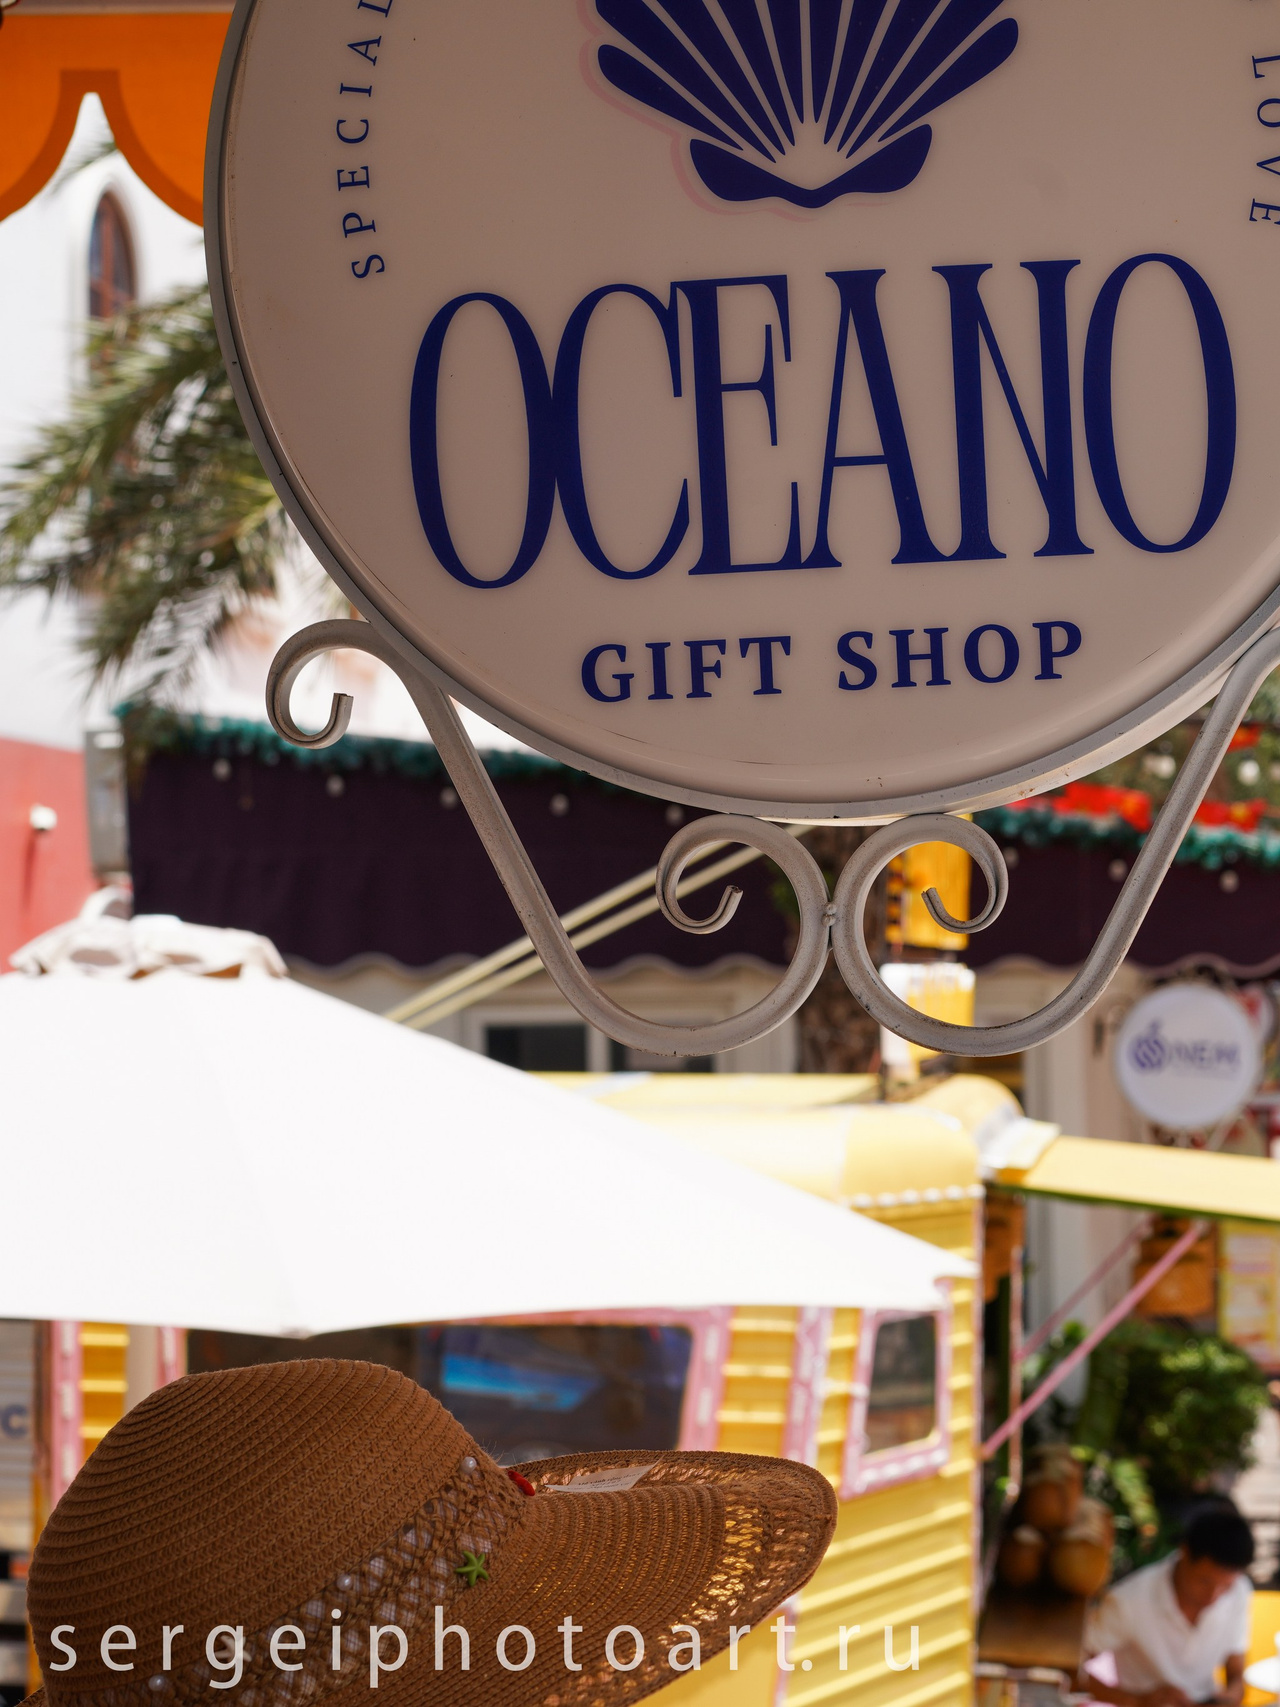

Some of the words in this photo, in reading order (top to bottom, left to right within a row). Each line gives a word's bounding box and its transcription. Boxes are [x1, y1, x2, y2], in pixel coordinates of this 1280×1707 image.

[409, 253, 1237, 589] OCEANO
[581, 636, 792, 703] GIFT
[837, 620, 1084, 692] SHOP
